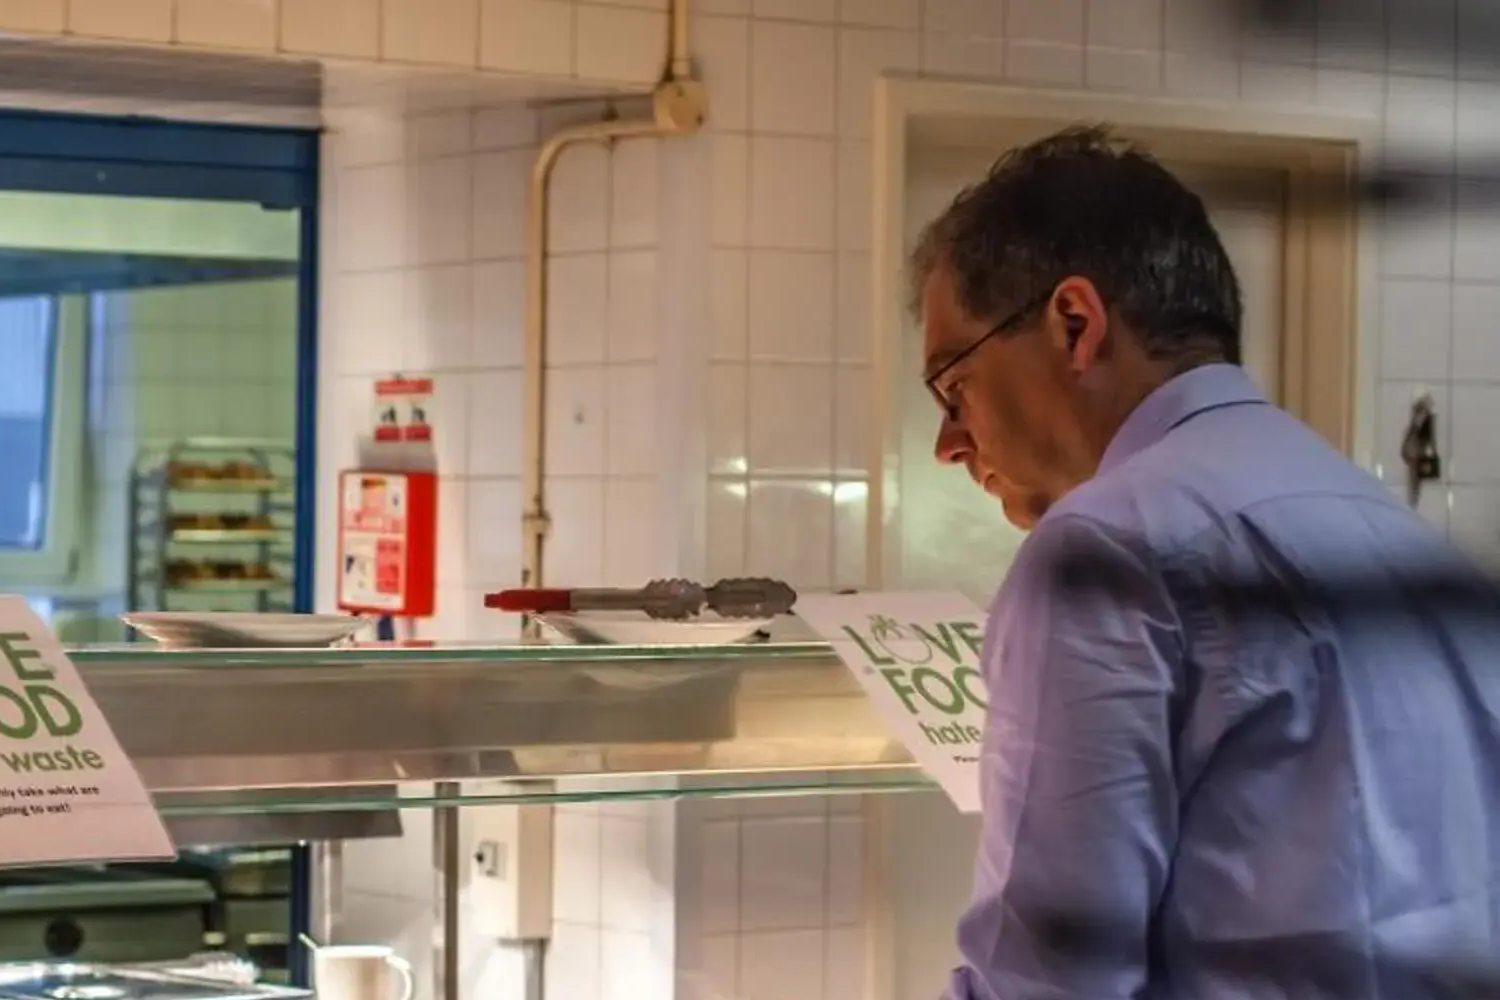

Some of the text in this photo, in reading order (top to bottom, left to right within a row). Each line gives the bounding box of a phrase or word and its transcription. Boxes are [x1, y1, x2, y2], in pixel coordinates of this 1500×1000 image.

[918, 720, 982, 746] hate
[2, 746, 106, 775] waste
[17, 786, 45, 797] take
[46, 785, 78, 796] what
[79, 785, 101, 796] are
[30, 804, 45, 814] to
[46, 802, 72, 814] eat!
